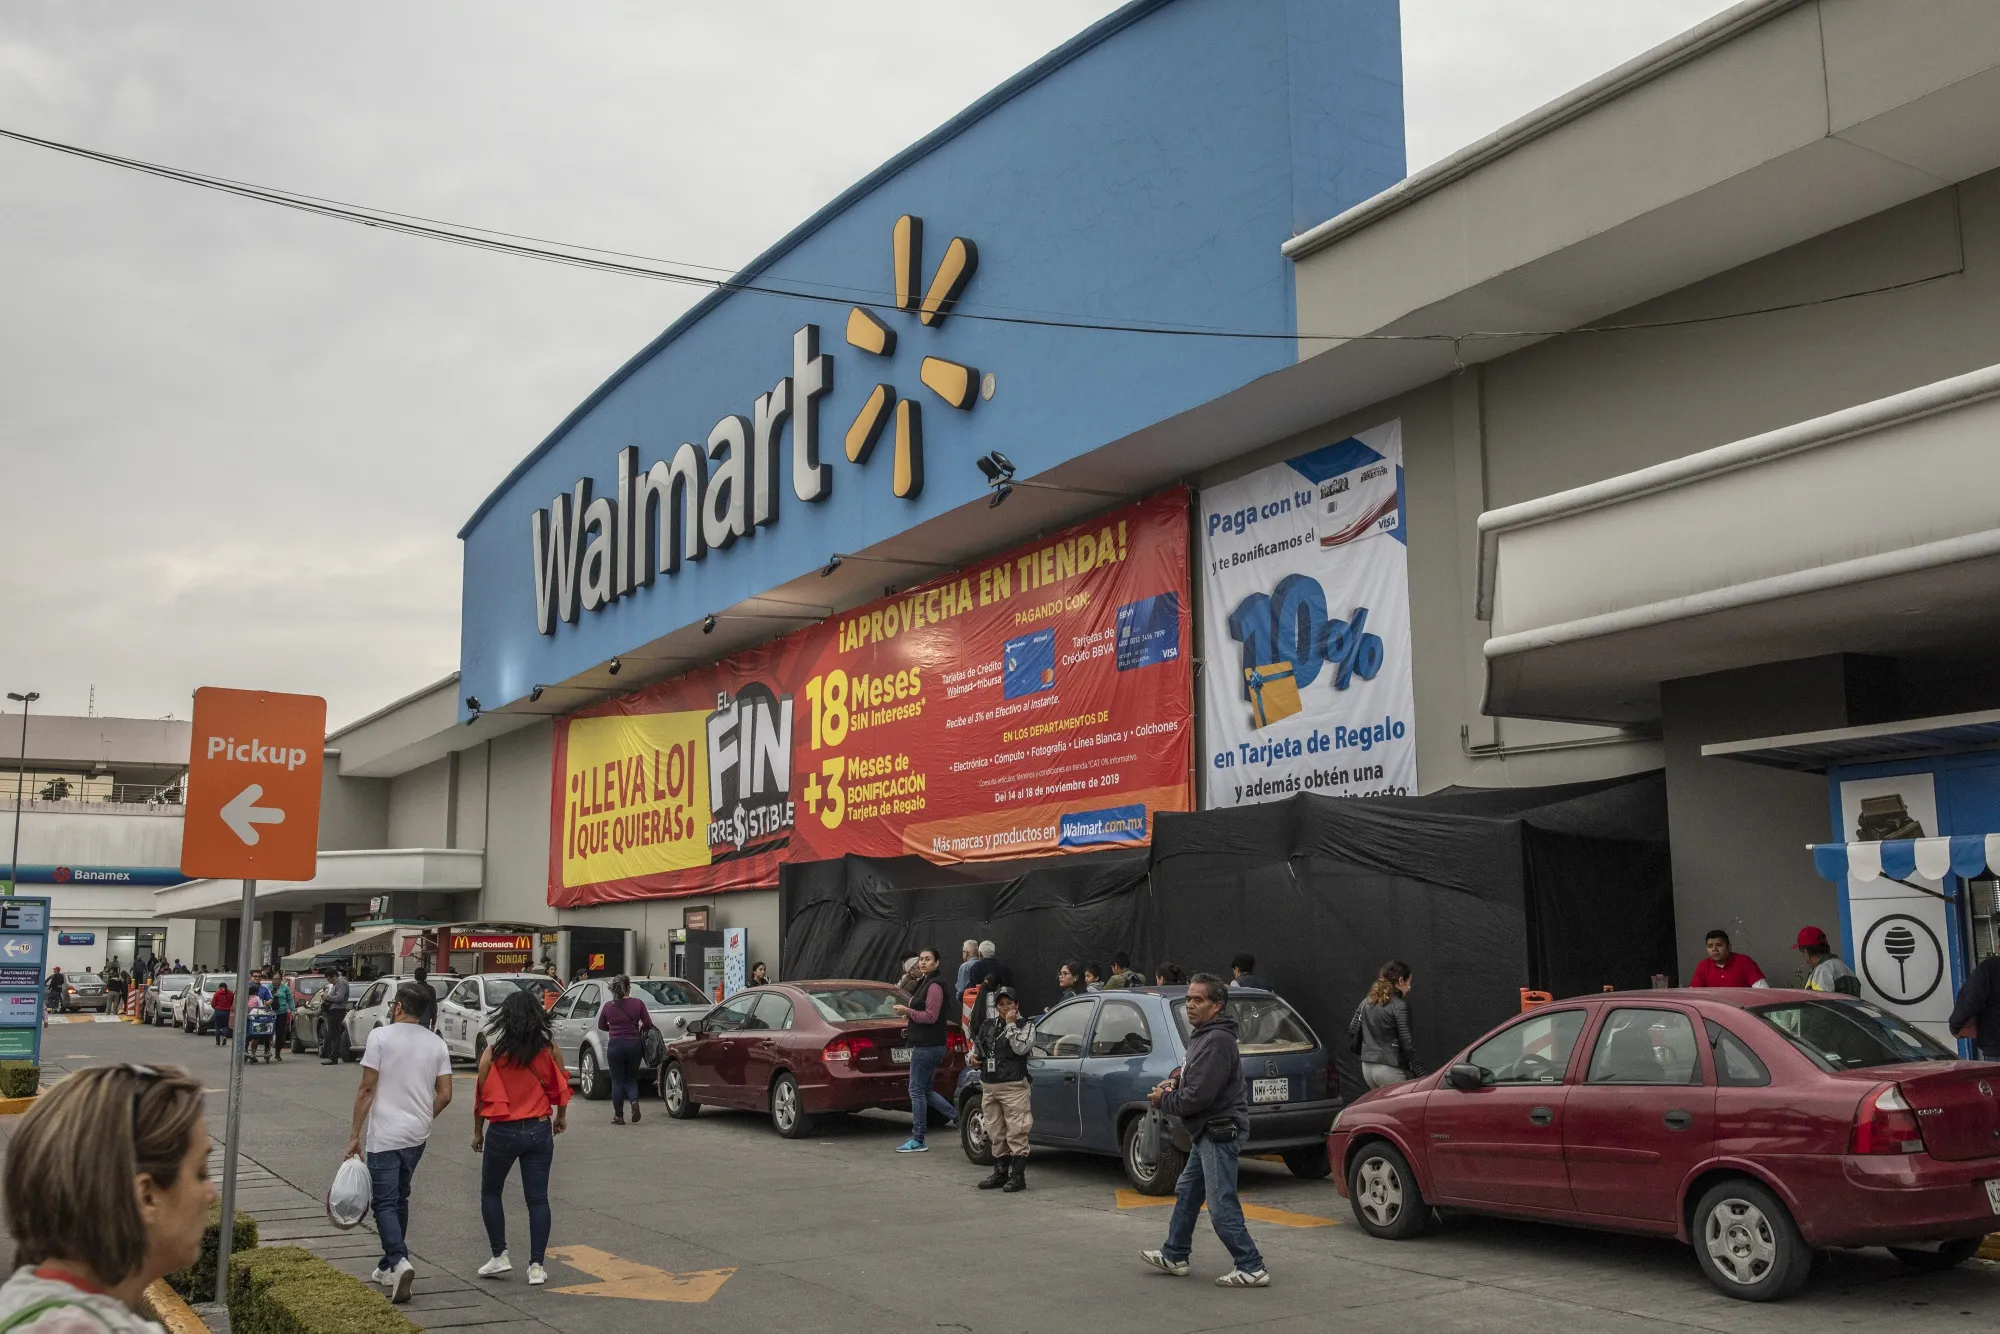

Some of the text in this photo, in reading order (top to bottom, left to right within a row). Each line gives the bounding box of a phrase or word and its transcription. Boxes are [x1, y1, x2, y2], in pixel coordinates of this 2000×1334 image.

[532, 324, 834, 636] Walmart
[1208, 490, 1312, 537] Paga con tu
[1378, 516, 1396, 529] VISA
[1212, 527, 1315, 576] y te Bonificamos el
[839, 520, 1127, 654] ¡APROVECHA EN TIENDA!
[1015, 592, 1091, 627] PAGANDO CON:
[1072, 628, 1115, 648] Tarjetas de
[1162, 647, 1178, 659] VISA
[1229, 573, 1384, 703] 10%
[1062, 649, 1091, 666] Crédito
[1092, 645, 1115, 659] BBVA
[942, 660, 1002, 685] Tarjetas de Crédito
[717, 691, 730, 712] EL
[805, 667, 921, 751] 18 Meses
[945, 716, 967, 730] Recibe
[967, 714, 974, 725] el
[974, 711, 984, 722] 3%
[985, 711, 994, 720] en
[995, 704, 1022, 719] Efectivo
[1022, 702, 1030, 714] al
[850, 711, 869, 732] SIN
[1003, 710, 1109, 743] EN LOS DEPARTAMENTOS DE
[207, 736, 307, 771] Pickup
[708, 699, 793, 814] FIN
[953, 720, 1179, 772] Electrónica Cómputo Fotografía Línea Blanca y Colchones
[1213, 715, 1406, 769] en Tarjeta de Regalo
[848, 752, 909, 780] Meses de
[803, 756, 846, 830] +3
[847, 771, 926, 804] BONIFICACIÓN
[994, 773, 1120, 803] Del 14 al 18 de noviembre de 2019
[1234, 764, 1384, 804] y además obtén una
[847, 795, 926, 822] Tarjeta de Regalo
[577, 820, 609, 860] QUE
[707, 802, 795, 852] IRRE$ISTIBLE
[932, 823, 1056, 853] Más marcas y productos en
[1063, 817, 1143, 838] Walmart.com.mx
[74, 870, 130, 881] Banamex
[471, 941, 514, 949] McDonald's
